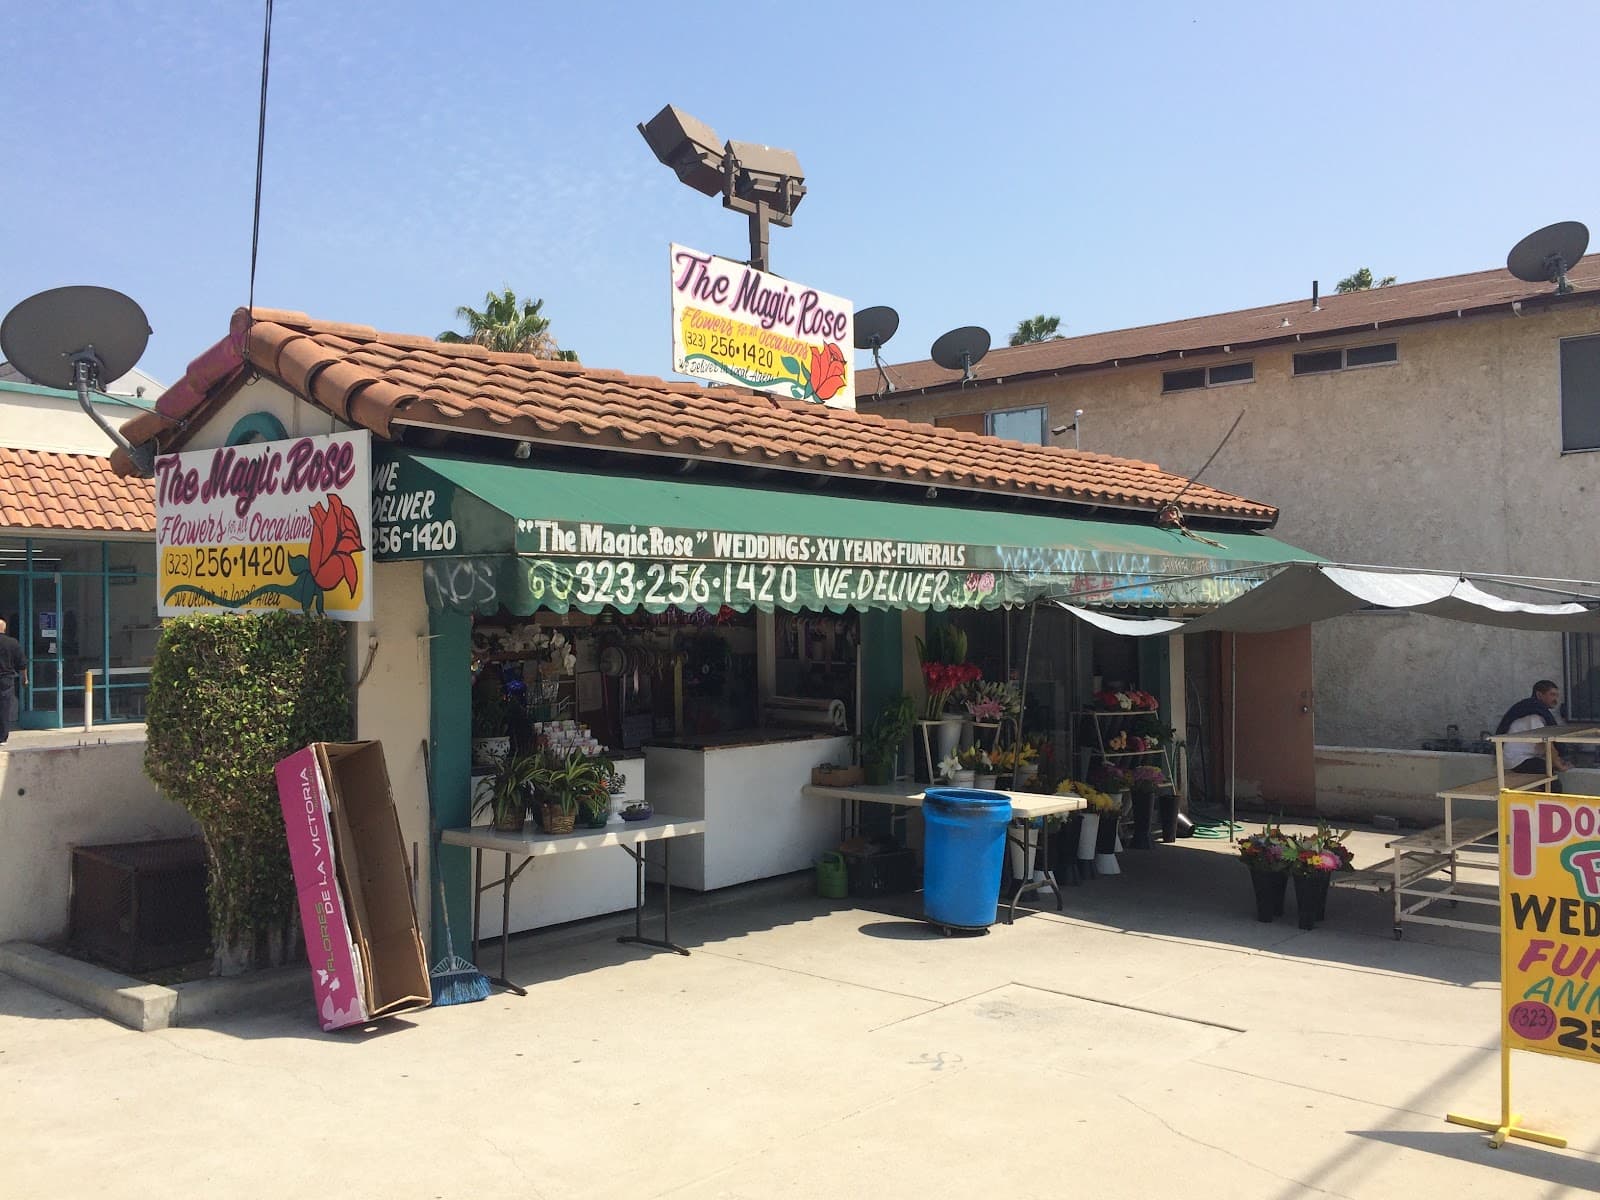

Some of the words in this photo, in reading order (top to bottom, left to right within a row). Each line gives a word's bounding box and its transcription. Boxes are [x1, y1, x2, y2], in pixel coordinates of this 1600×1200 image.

[675, 253, 730, 303] The
[730, 268, 796, 329] Magic
[796, 290, 848, 341] Rose
[680, 306, 733, 336] Flowers
[685, 331, 706, 350] (323)
[156, 452, 200, 507] The
[201, 445, 282, 519] Magic
[281, 438, 355, 495] Rose
[372, 462, 400, 491] WE
[372, 490, 435, 522] DELIVER
[159, 510, 226, 545] Flowers
[248, 509, 312, 542] Occasions
[580, 524, 648, 557] Magic
[165, 553, 193, 578] (323)
[300, 767, 322, 857] VICTORIA
[1538, 803, 1600, 844] DO
[317, 861, 328, 886] LA
[321, 890, 335, 914] DE
[315, 902, 336, 972] FLORES
[1512, 1006, 1555, 1034] (323)
